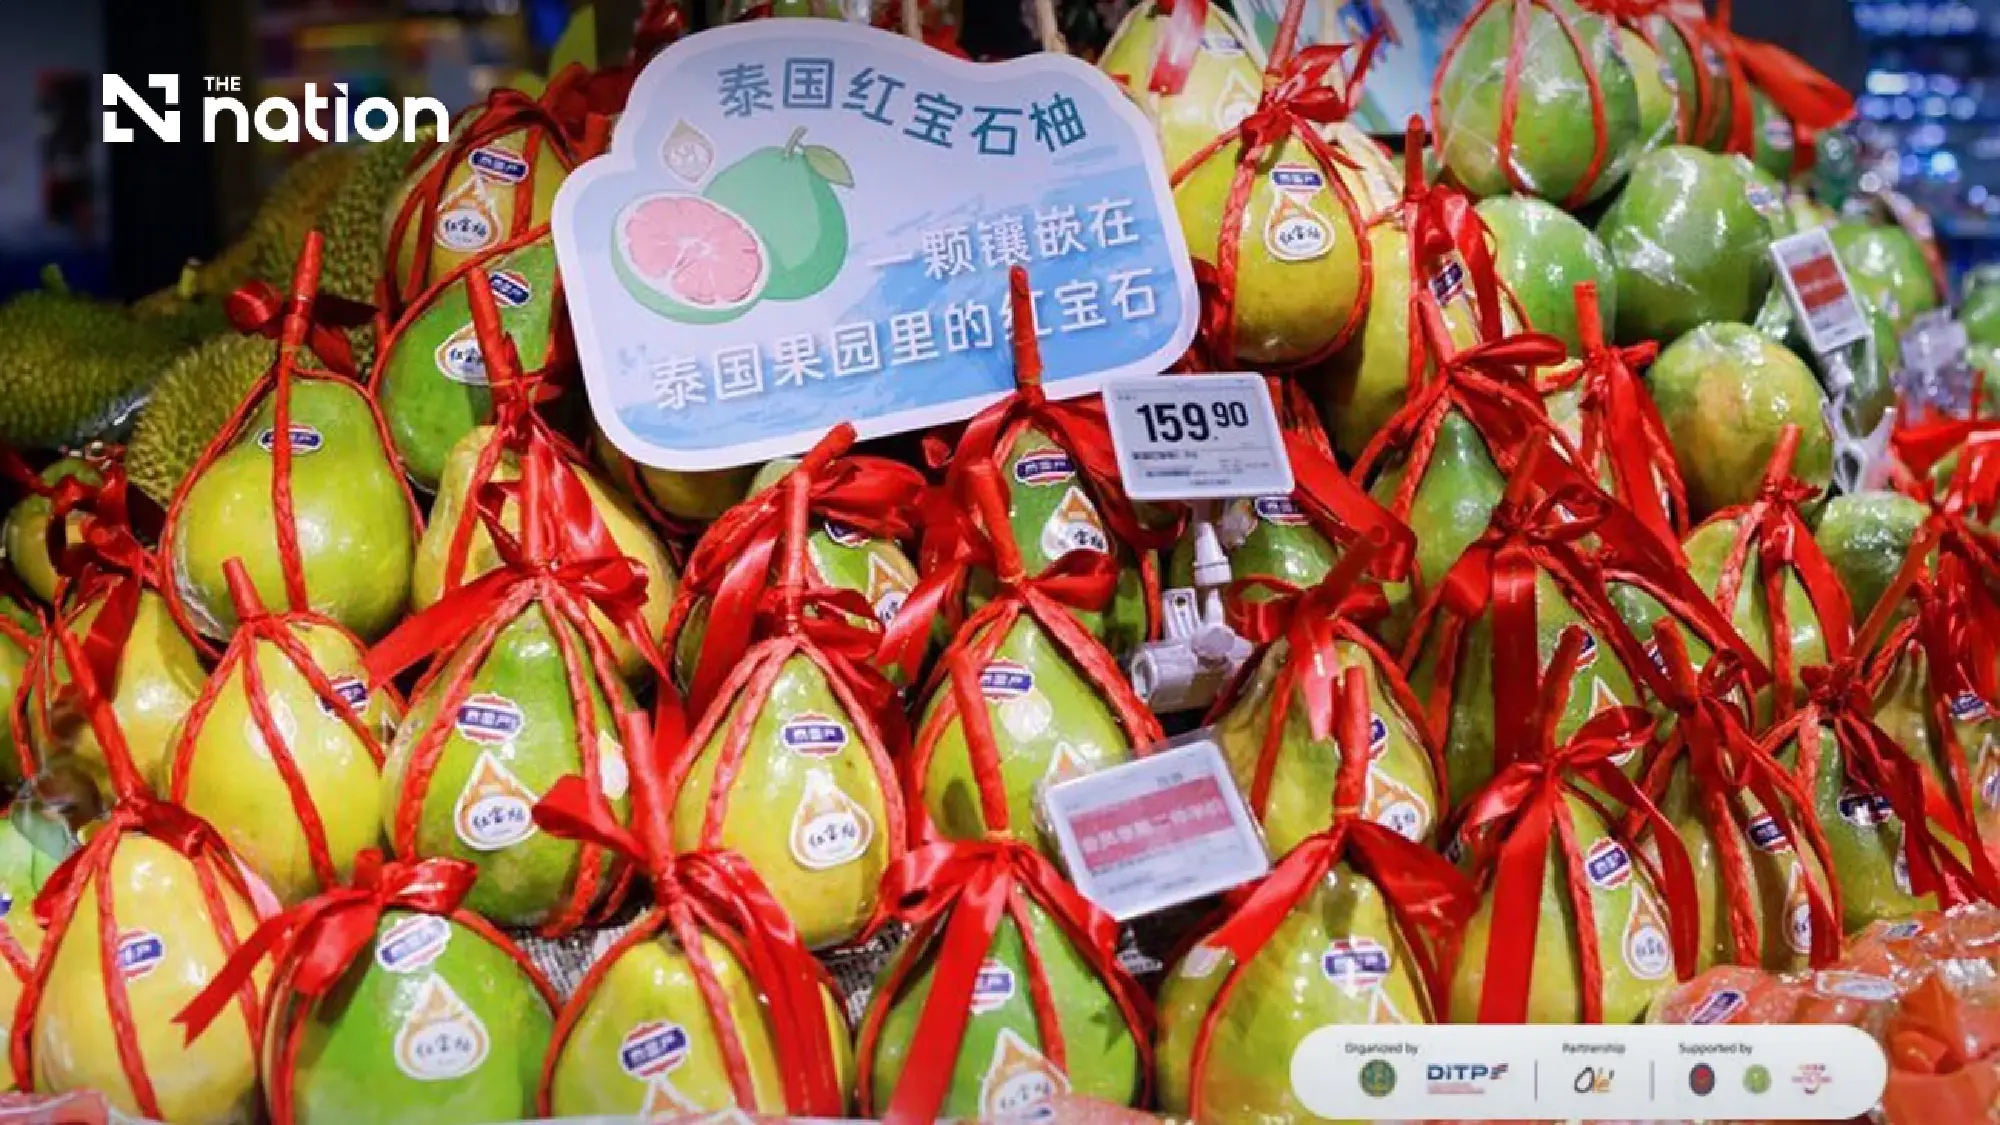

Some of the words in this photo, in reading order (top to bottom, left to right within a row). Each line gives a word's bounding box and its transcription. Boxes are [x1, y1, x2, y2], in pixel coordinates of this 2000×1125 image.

[717, 57, 1088, 156] 泰国红宝石柚
[866, 198, 1140, 280] 一颗镶嵌在
